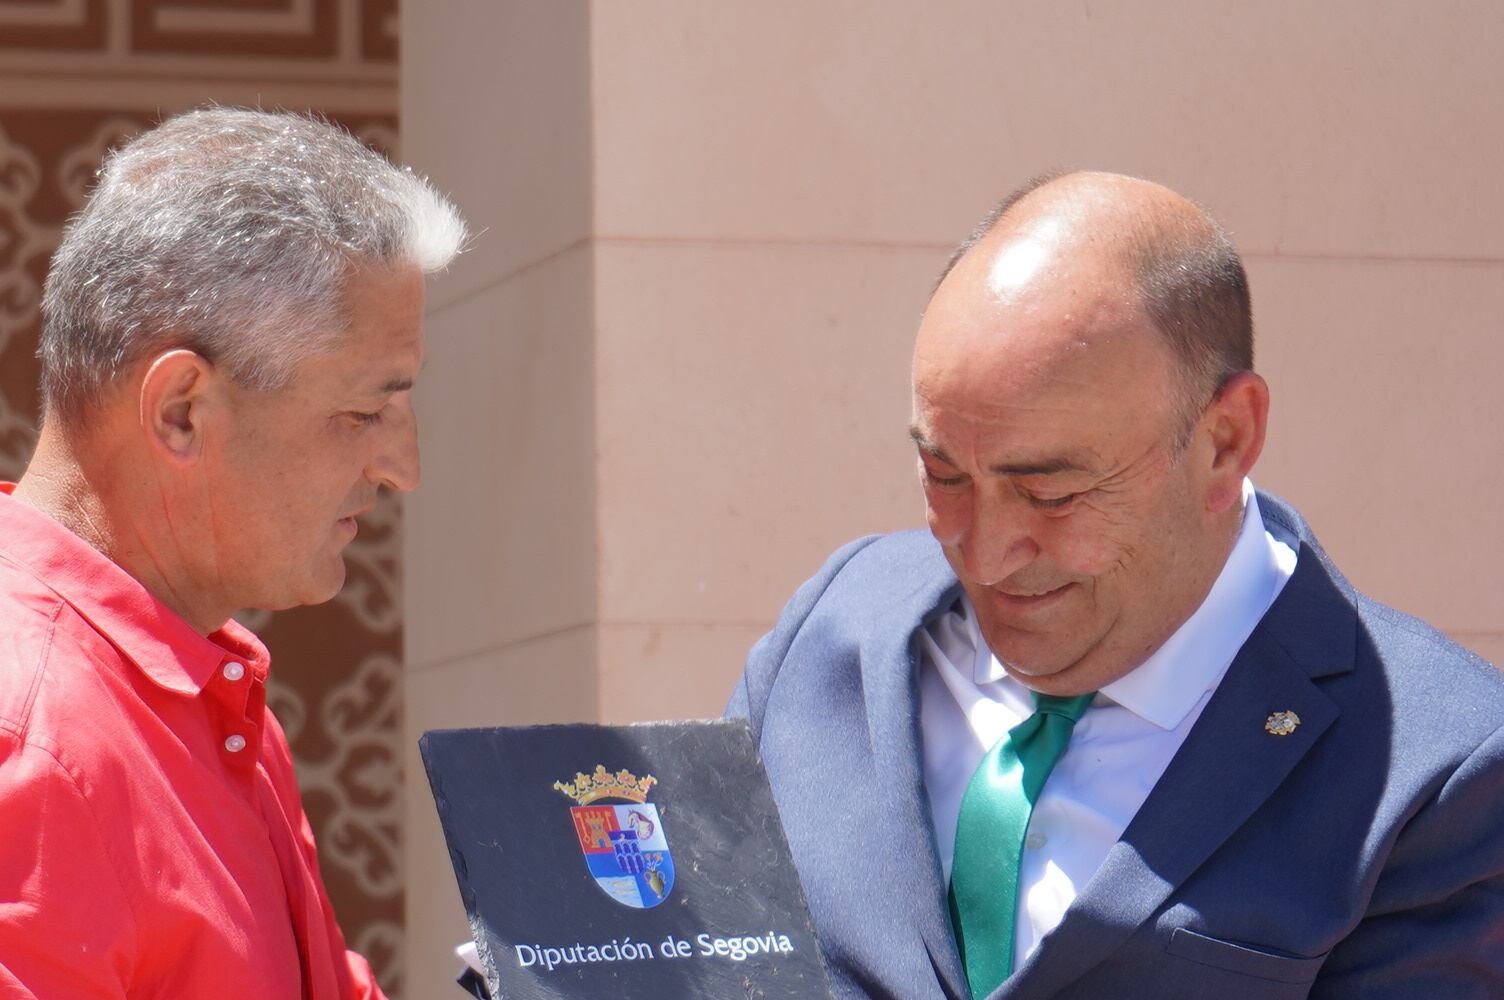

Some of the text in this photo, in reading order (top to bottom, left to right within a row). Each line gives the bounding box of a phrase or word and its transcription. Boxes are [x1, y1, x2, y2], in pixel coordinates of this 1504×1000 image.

[515, 931, 793, 970] Diputación de Segovia
